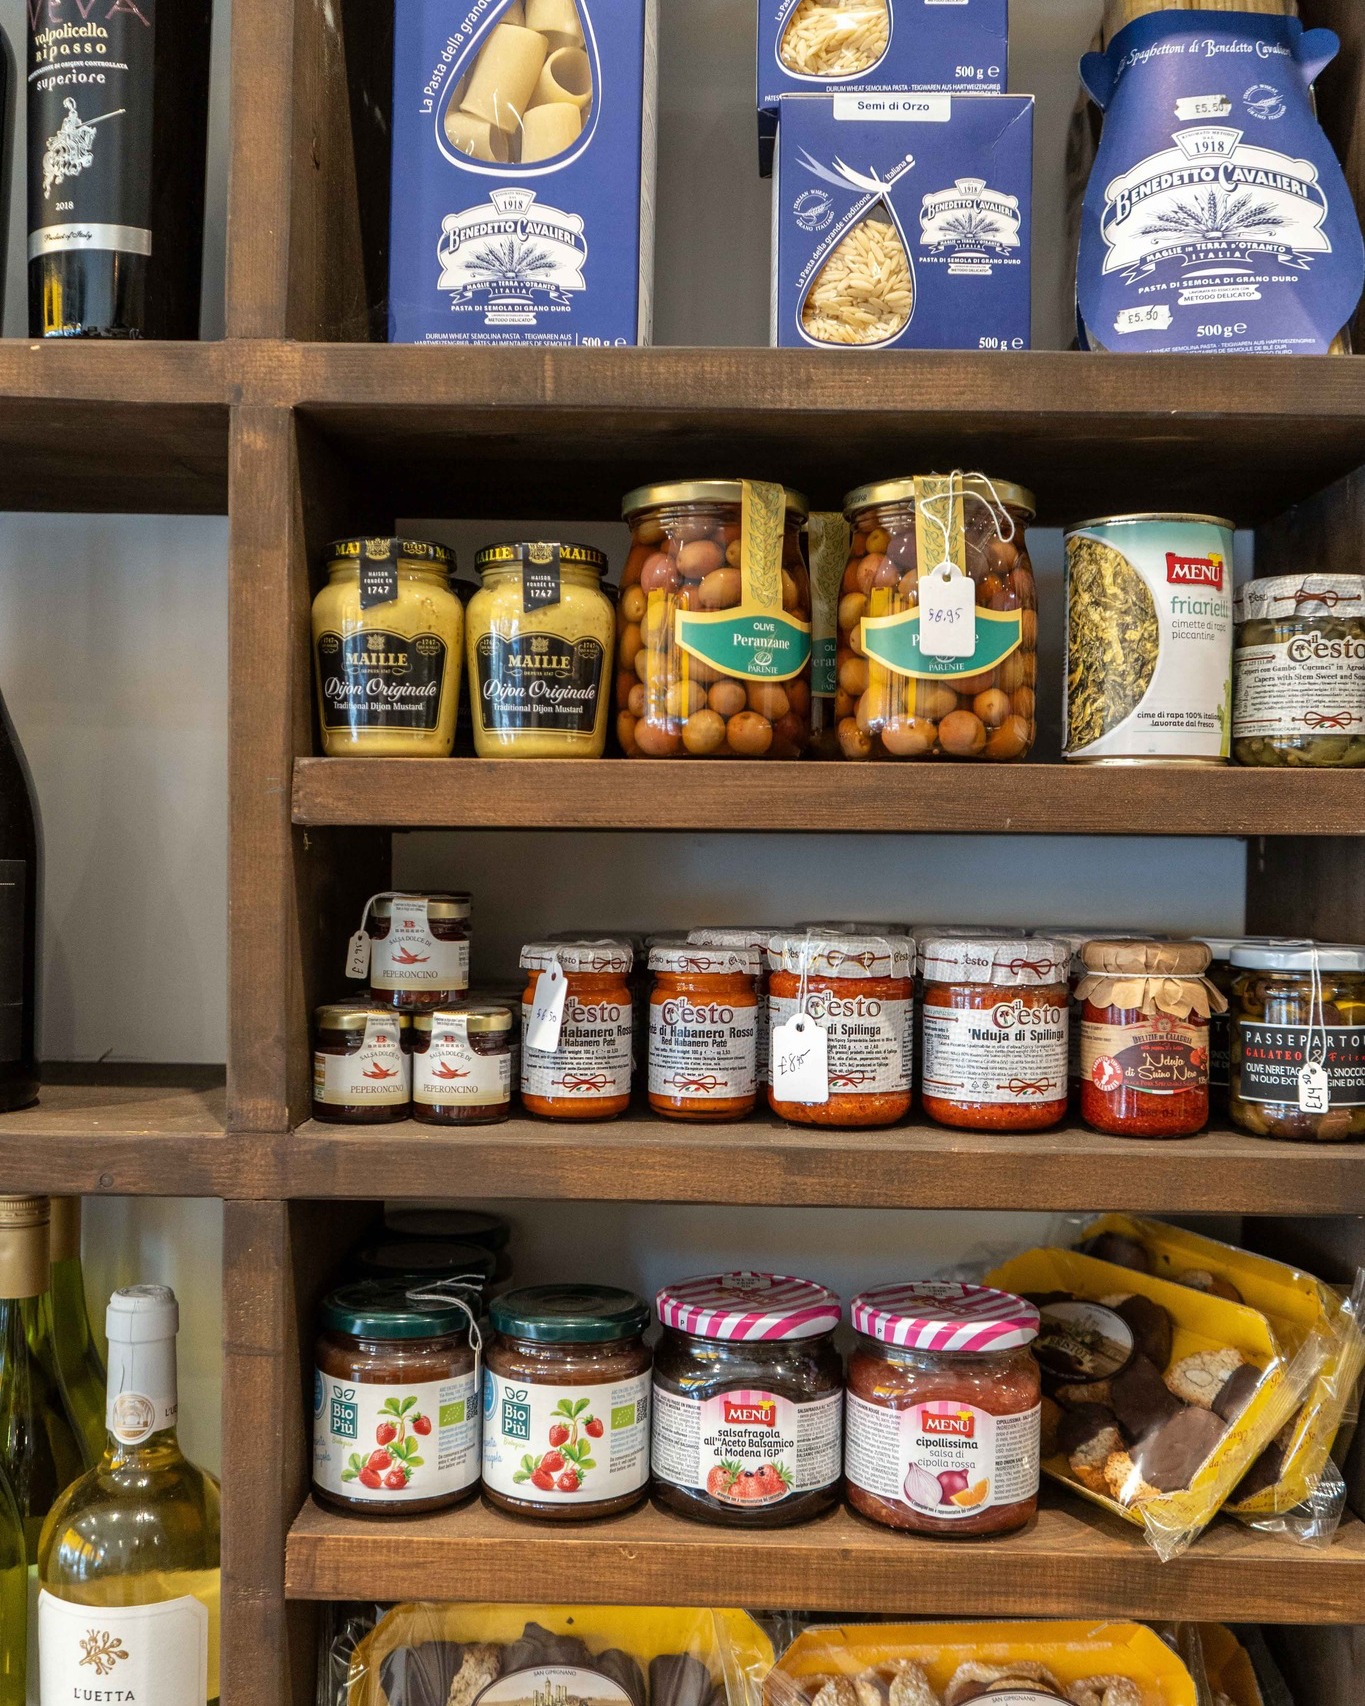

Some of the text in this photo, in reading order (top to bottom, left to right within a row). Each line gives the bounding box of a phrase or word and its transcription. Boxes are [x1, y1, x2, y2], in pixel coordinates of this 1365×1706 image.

[35, 22, 108, 46] valpolicella
[36, 42, 107, 62] Ripasso
[1127, 43, 1185, 67] Spaghettoni
[1188, 40, 1199, 53] di
[1201, 39, 1253, 57] Benedetto
[85, 60, 129, 70] CONTROLLATA
[419, 32, 464, 113] La Pasta della
[955, 66, 973, 78] 500
[37, 69, 106, 91] superiore
[857, 101, 930, 112] Semi di Orzo
[1195, 103, 1224, 114] £5.50
[1194, 141, 1225, 153] 1918
[884, 160, 907, 181] Italiana
[793, 189, 829, 209] ITALIAN WHEAT
[1115, 161, 1308, 226] BENEDETTO CAVALIERI
[55, 201, 75, 211] 2018
[503, 200, 523, 210] 1918
[927, 197, 1013, 221] BENEDETTO CAVALIERI
[796, 211, 835, 232] GRANO ITALIANO
[448, 217, 576, 255] BENEDETTO CAVALIERI
[795, 193, 872, 288] La Pasta della grande tradizione
[1146, 241, 1286, 262] MAGLIE TERRA D'OTRANTO
[1192, 251, 1242, 261] ITALIA
[466, 281, 490, 291] MAGLIE
[1138, 284, 1168, 294] PASTA
[1182, 277, 1221, 288] SEMOLA
[1236, 275, 1270, 283] GRANO
[1271, 275, 1299, 283] DURO
[1183, 293, 1216, 302] METODO
[1128, 311, 1159, 324] £5.50
[448, 332, 470, 340] WHEAT
[1196, 324, 1223, 338] 500
[979, 337, 998, 349] 500
[366, 586, 389, 595] 1747
[1170, 596, 1229, 618] friarielli
[753, 622, 775, 632] OLIVE
[1171, 620, 1205, 629] cimette
[733, 633, 790, 650] Peranzane
[1172, 631, 1215, 641] piccantine
[345, 653, 408, 666] MAILLE
[508, 655, 571, 669] MAILLE
[747, 665, 778, 674] PARENTE
[928, 663, 965, 672] PARENTE
[1254, 676, 1276, 684] Capers
[325, 677, 437, 702] Dijon Originale
[483, 679, 596, 704] Dijon Originale
[333, 701, 423, 712] Traditional Dijon Mustard
[493, 703, 583, 714] Traditional Dijon Mustard
[1157, 711, 1165, 719] di
[1166, 713, 1184, 721] rapa
[405, 935, 424, 943] DOLCE
[382, 969, 438, 979] PEPERONCINO
[662, 1001, 734, 1026] Cesto
[991, 1004, 1061, 1029] Cesto
[561, 1025, 614, 1038] Habanero
[659, 1025, 754, 1039] di Habanero Rosso
[841, 1024, 881, 1037] Spilinga
[968, 1028, 1064, 1043] 'Nduja di Spilinga
[564, 1038, 600, 1047] Habanero
[661, 1037, 728, 1048] Red Habanero Paté
[1245, 1048, 1302, 1061] GALATEO
[1138, 1065, 1171, 1080] Suino
[1246, 1062, 1285, 1075] OLIVE NERE
[1250, 1074, 1280, 1084] IN OLIO
[350, 1084, 404, 1094] PEPERONCINO
[423, 1083, 479, 1094] PEPERONCINO
[332, 1402, 354, 1419] Bio
[504, 1405, 526, 1421] Bio
[332, 1417, 354, 1436] Più
[504, 1419, 526, 1436] Più
[717, 1428, 780, 1440] salsafragola
[748, 1438, 794, 1449] Balsamico
[916, 1437, 978, 1450] cipollissima
[714, 1447, 723, 1456] di
[725, 1448, 762, 1458] Modena
[929, 1450, 964, 1458] salsa di
[917, 1459, 976, 1469] cipolla rossa
[74, 1687, 135, 1702] L'UETTA
